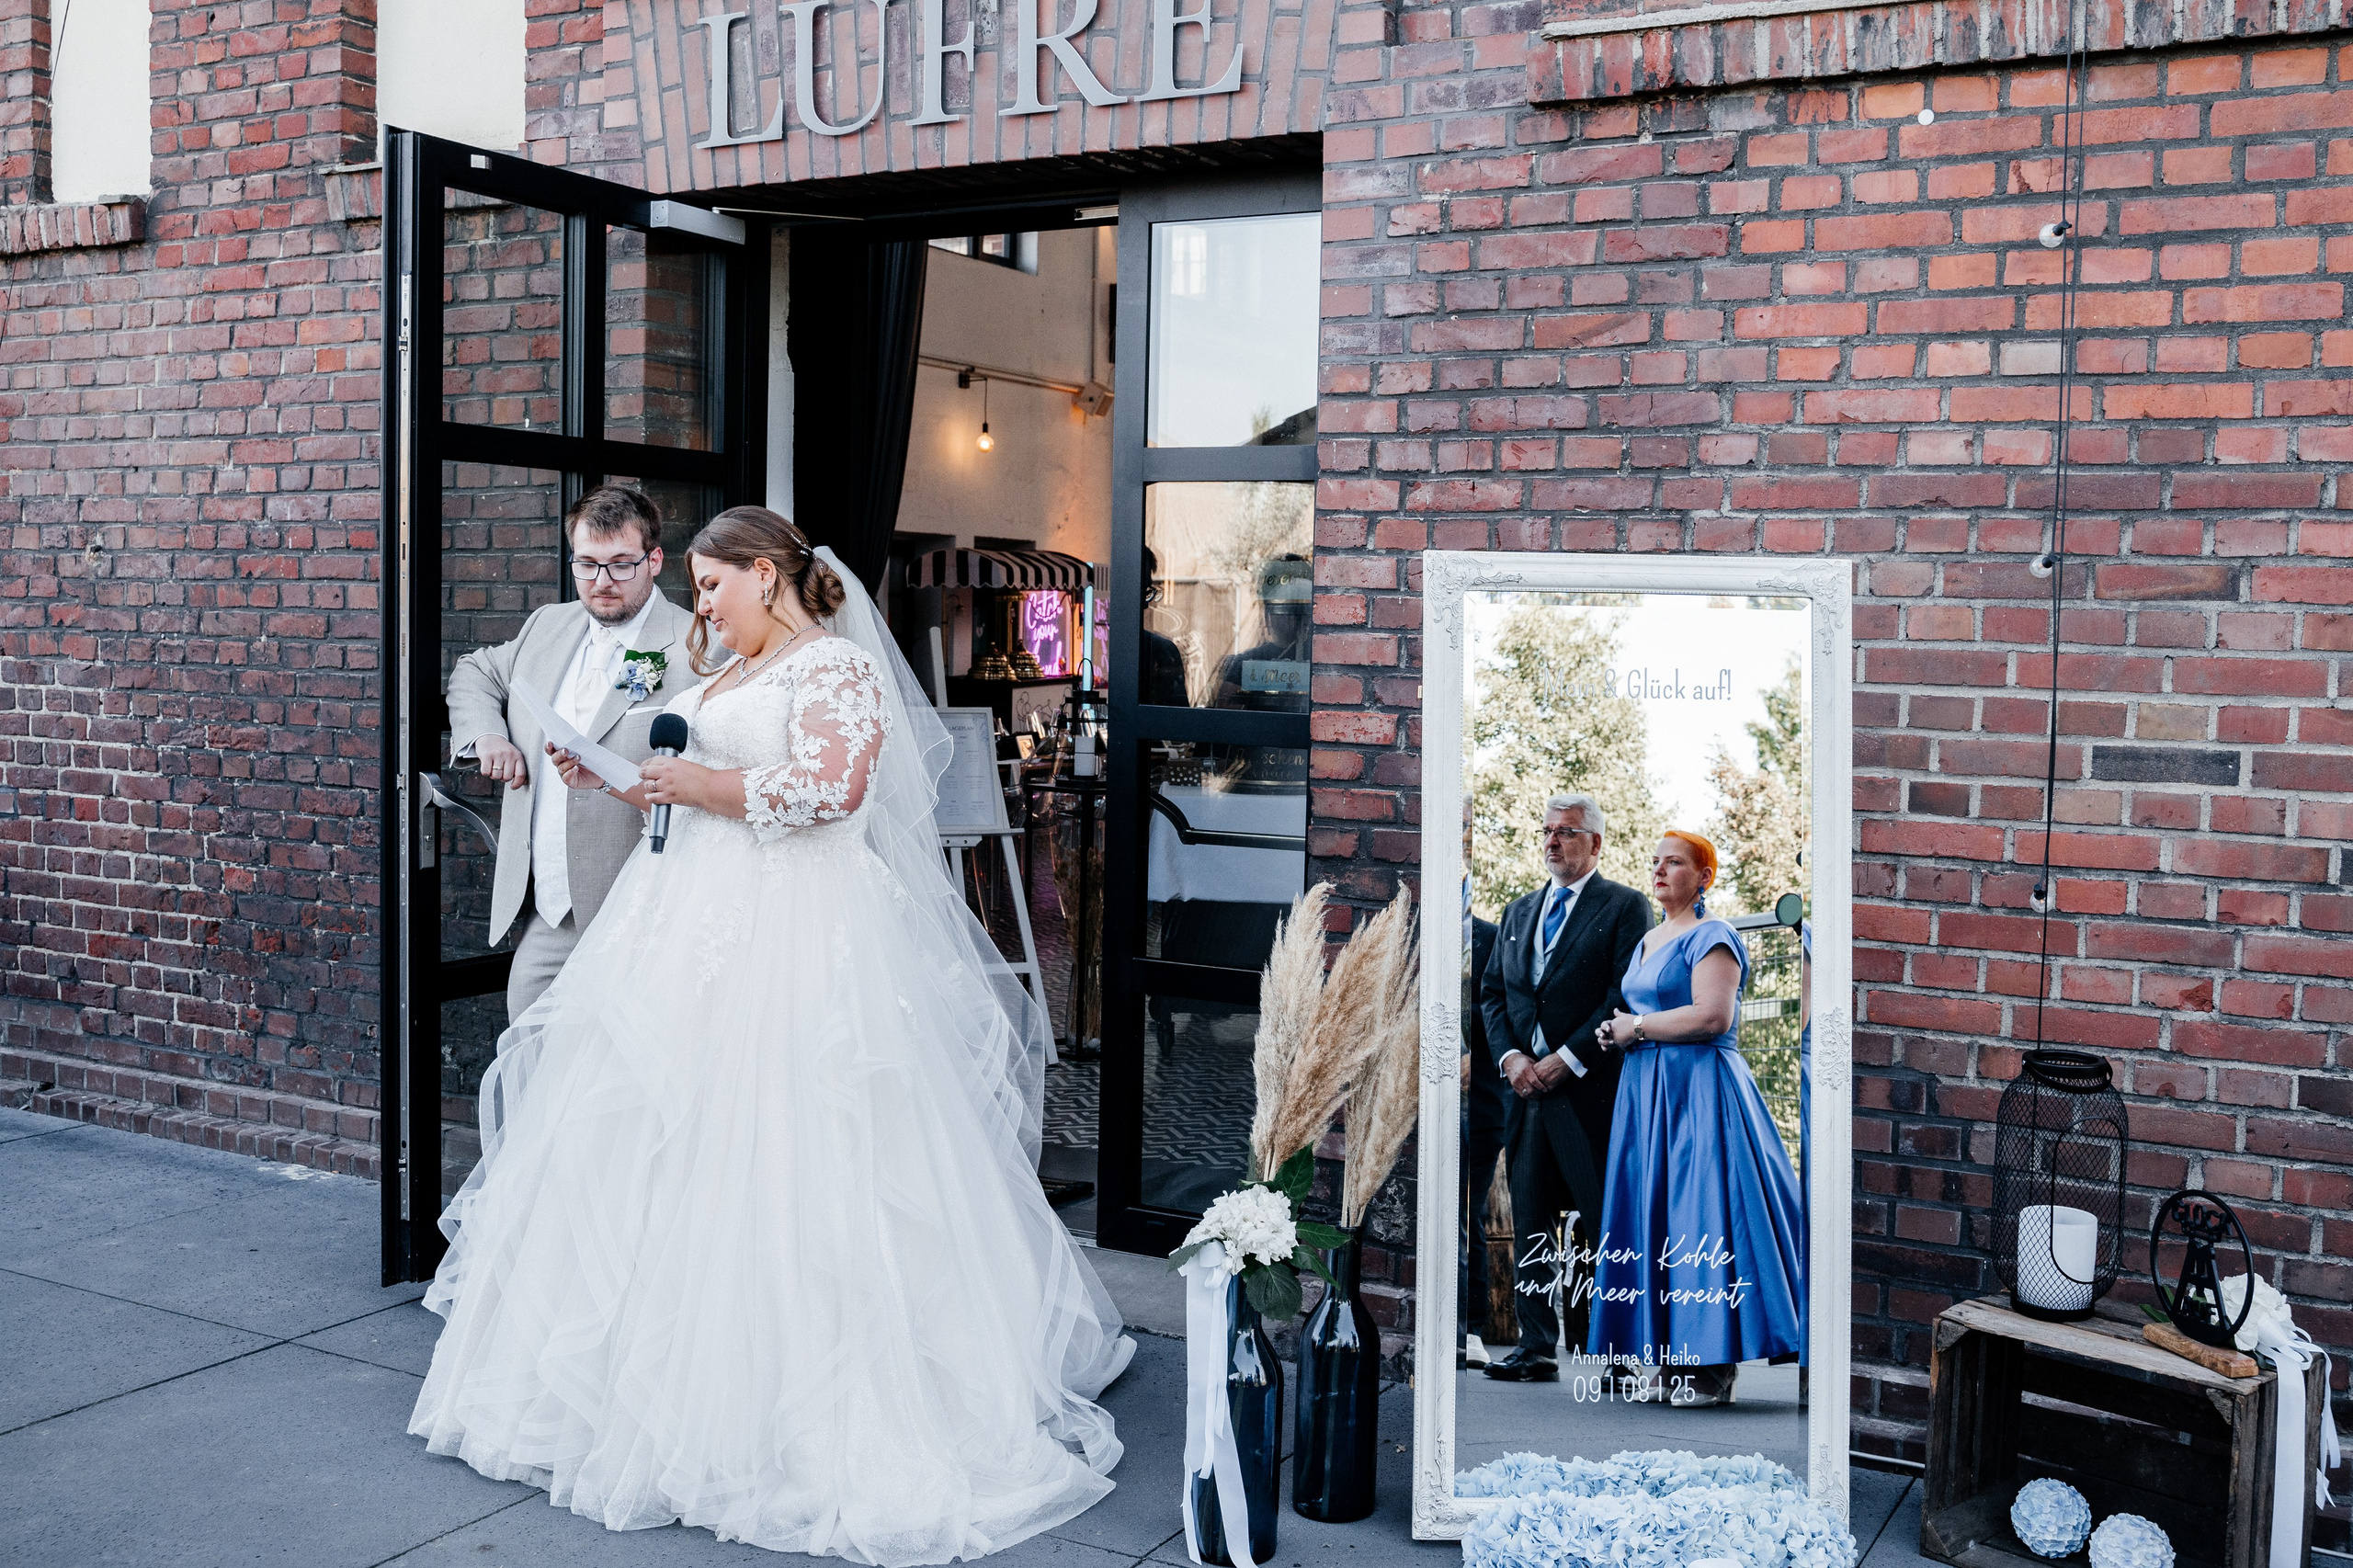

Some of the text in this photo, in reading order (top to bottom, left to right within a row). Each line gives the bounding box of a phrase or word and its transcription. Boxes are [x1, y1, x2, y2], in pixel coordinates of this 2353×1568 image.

[1544, 667, 1732, 700] Moin & Glück auf!
[1518, 1232, 1736, 1271] Zwischen Kohle
[1571, 1272, 1645, 1309] Meer
[1660, 1276, 1752, 1309] vereint
[1571, 1342, 1700, 1367] Annalena & Heiko
